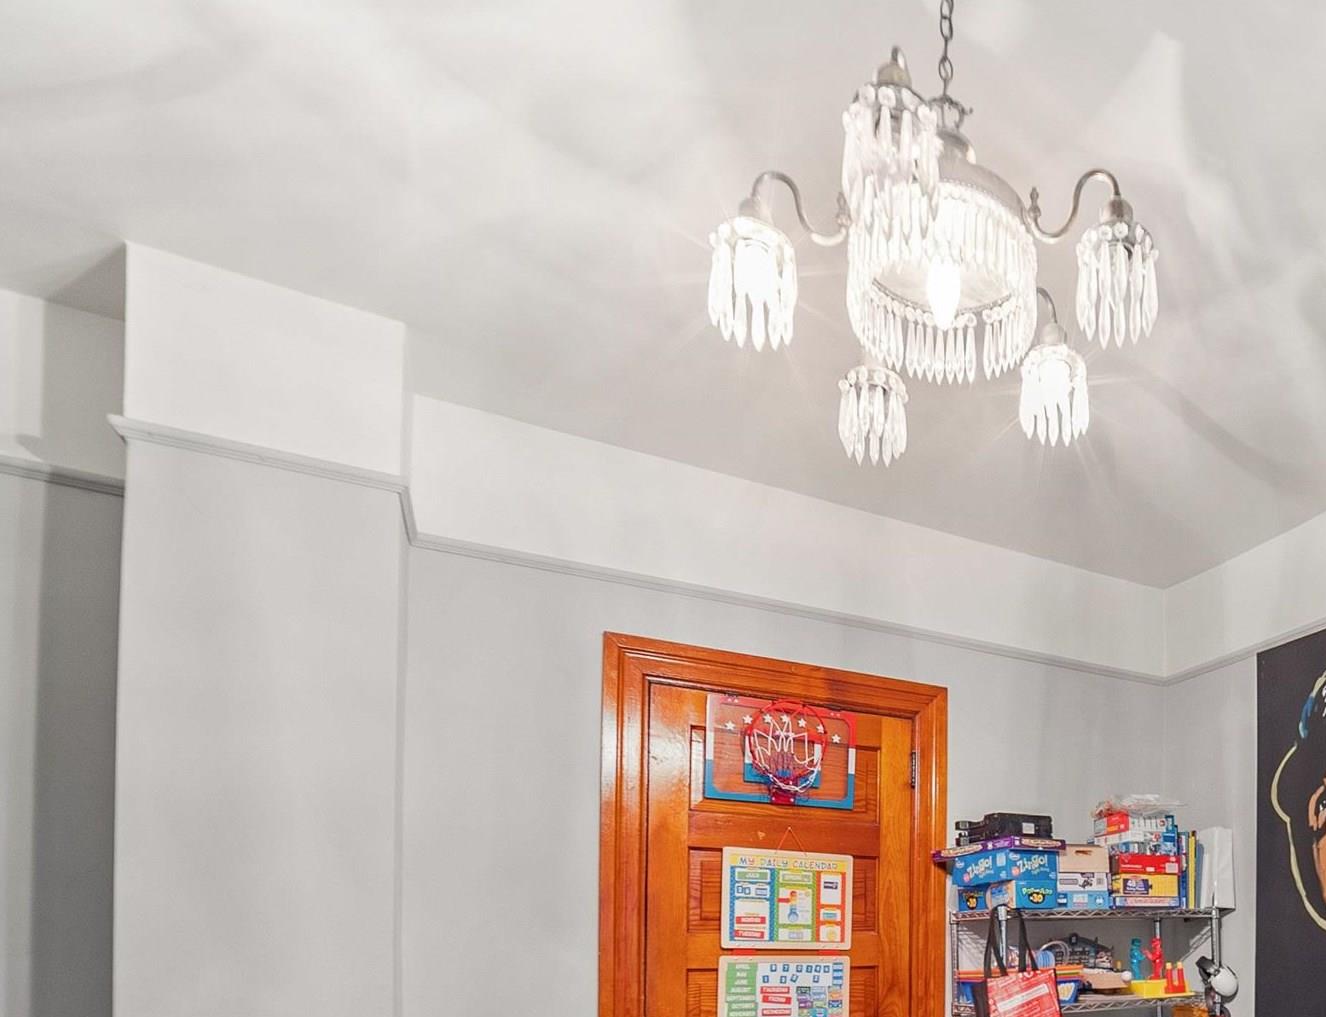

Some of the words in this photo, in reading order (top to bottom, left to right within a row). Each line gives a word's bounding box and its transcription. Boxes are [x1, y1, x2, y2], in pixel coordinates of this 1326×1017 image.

[739, 856, 756, 866] MY
[760, 857, 789, 868] DAILY
[792, 859, 839, 871] CALENDAR
